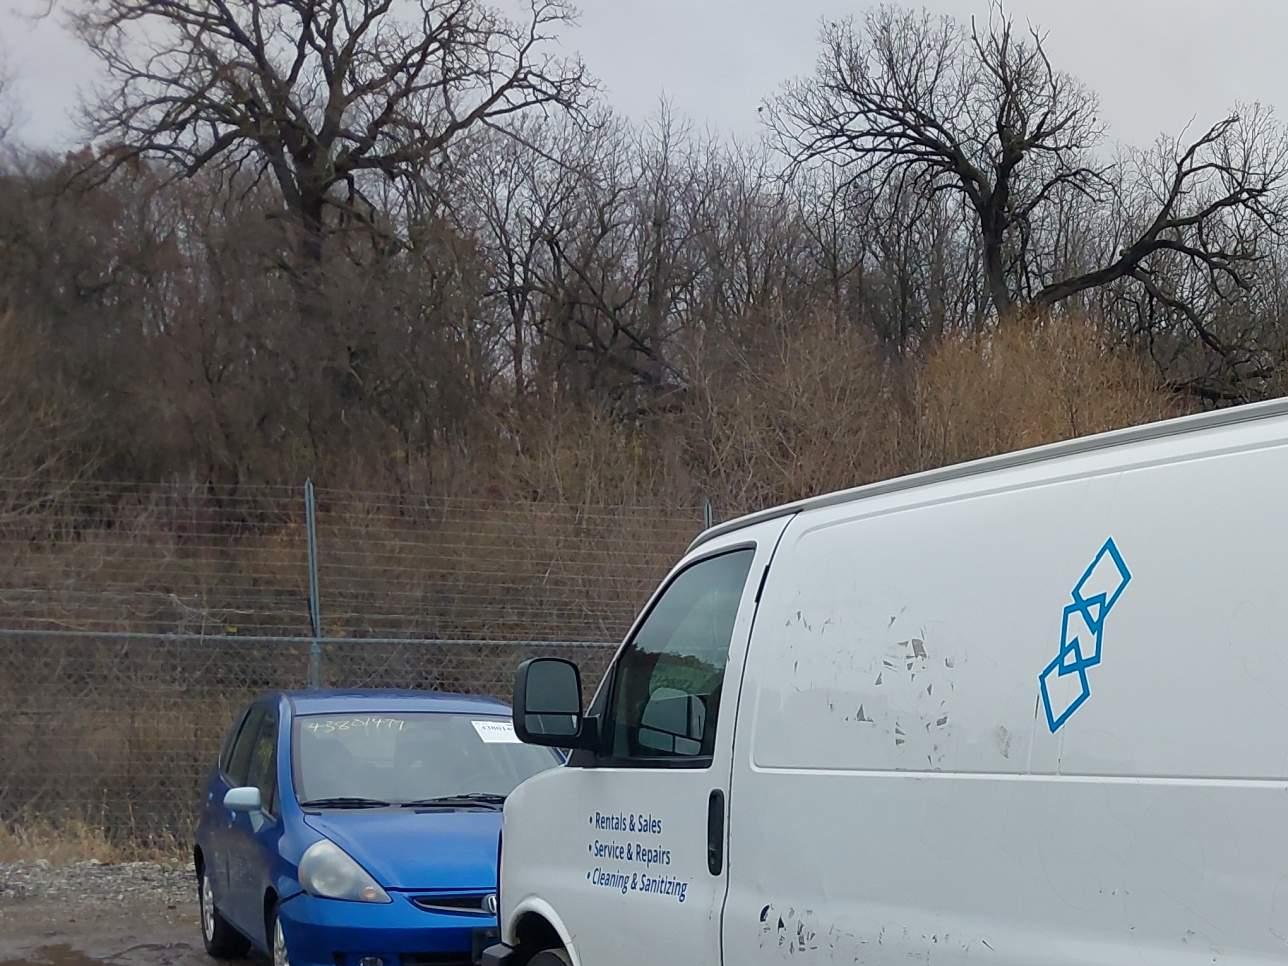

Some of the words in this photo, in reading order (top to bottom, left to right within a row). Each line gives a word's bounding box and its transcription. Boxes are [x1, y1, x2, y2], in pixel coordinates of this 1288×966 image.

[595, 812, 627, 832] Rentals
[629, 814, 636, 832] &
[638, 814, 662, 834] Sales
[593, 840, 625, 860] Service
[626, 842, 633, 861] &
[635, 843, 671, 868] Repairs
[592, 867, 629, 895] Cleaning
[630, 872, 638, 890] &
[639, 873, 688, 902] Sanitizing
